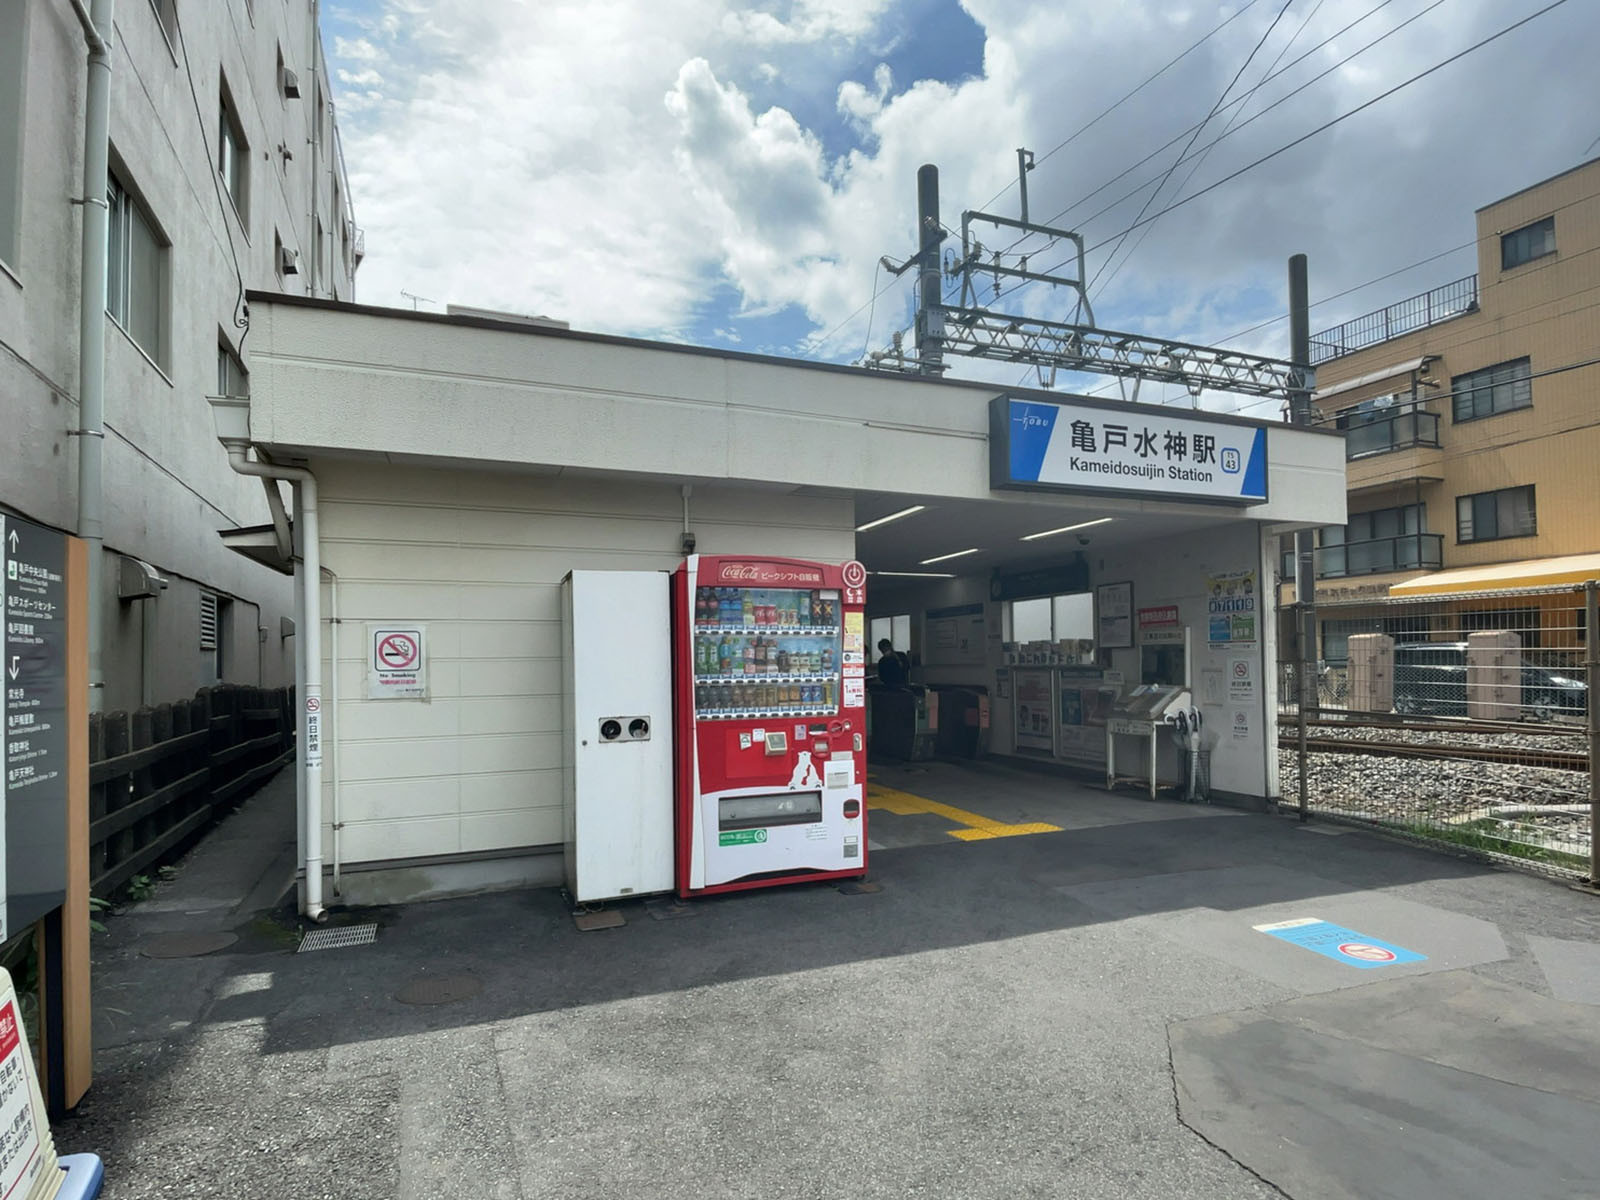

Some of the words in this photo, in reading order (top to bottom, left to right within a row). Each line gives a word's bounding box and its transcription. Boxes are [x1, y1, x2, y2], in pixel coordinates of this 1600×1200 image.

[1070, 419, 1216, 464] 亀戸水神駅
[1070, 457, 1165, 480] Kameidosuijin
[1168, 463, 1213, 483] Station
[1225, 459, 1236, 470] 43
[308, 716, 318, 752] 終日禁煙
